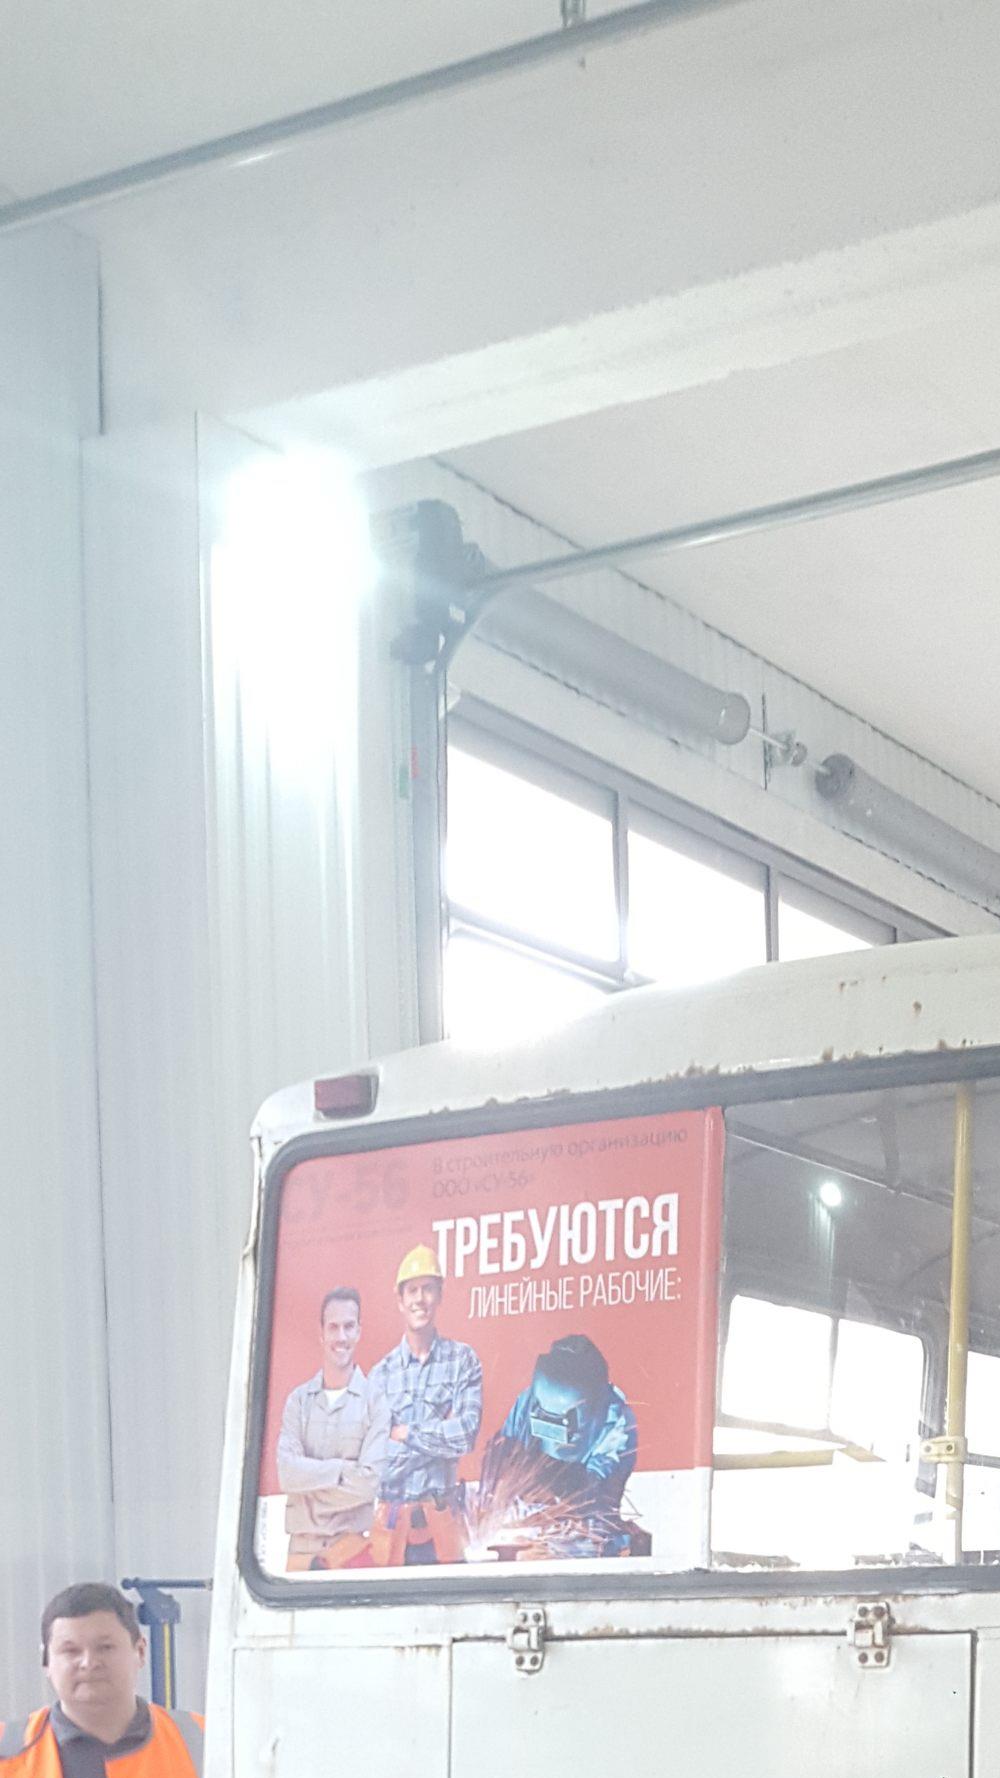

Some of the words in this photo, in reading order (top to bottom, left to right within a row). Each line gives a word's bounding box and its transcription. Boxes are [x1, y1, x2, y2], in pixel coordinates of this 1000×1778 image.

[448, 1144, 564, 1173] строительную
[567, 1129, 688, 1158] организацию
[433, 1178, 469, 1197] ООО
[432, 1193, 679, 1278] ТРЕБУЮТСЯ
[467, 1275, 573, 1320] ЛИНЕЙНЫЕ
[579, 1266, 682, 1308] РАБОЧИЕ:
